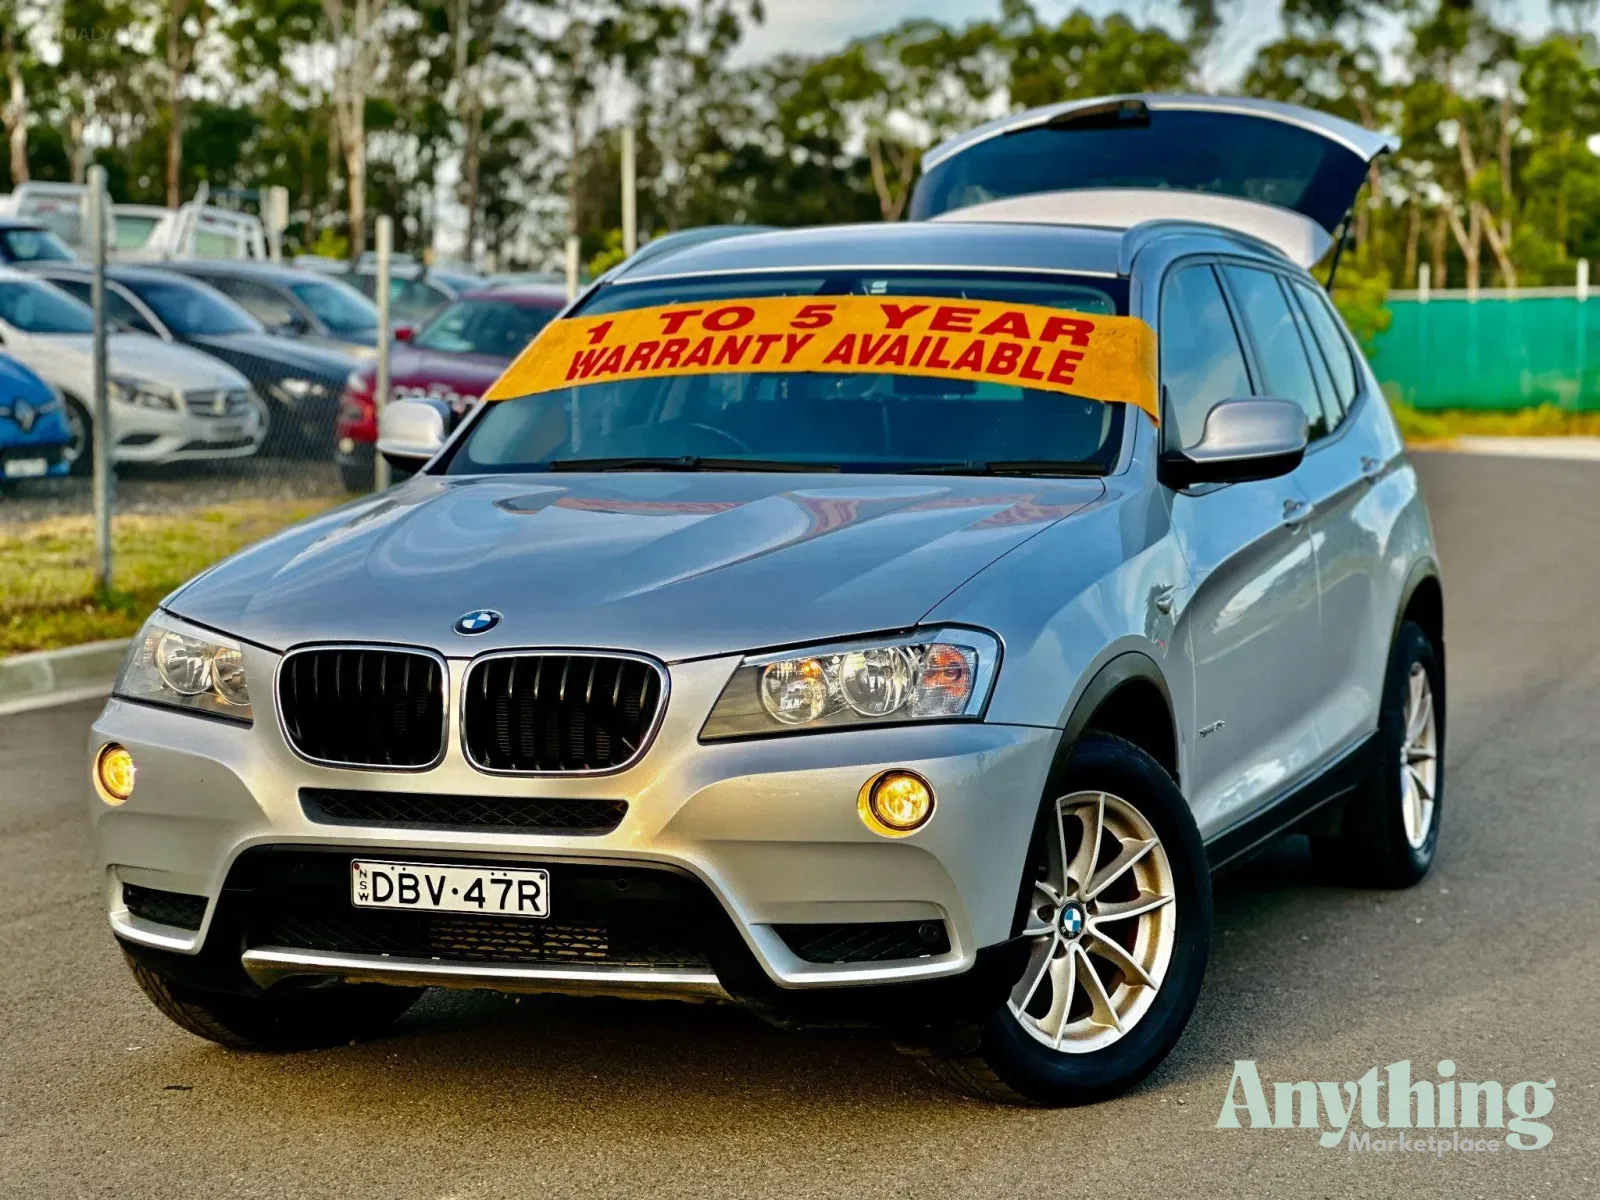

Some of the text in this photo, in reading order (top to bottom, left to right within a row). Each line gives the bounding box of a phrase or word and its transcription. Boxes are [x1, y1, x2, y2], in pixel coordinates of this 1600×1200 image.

[587, 304, 1096, 347] 1 TO 5 YEAR
[564, 333, 1085, 386] WARRANTY AVAILABLE
